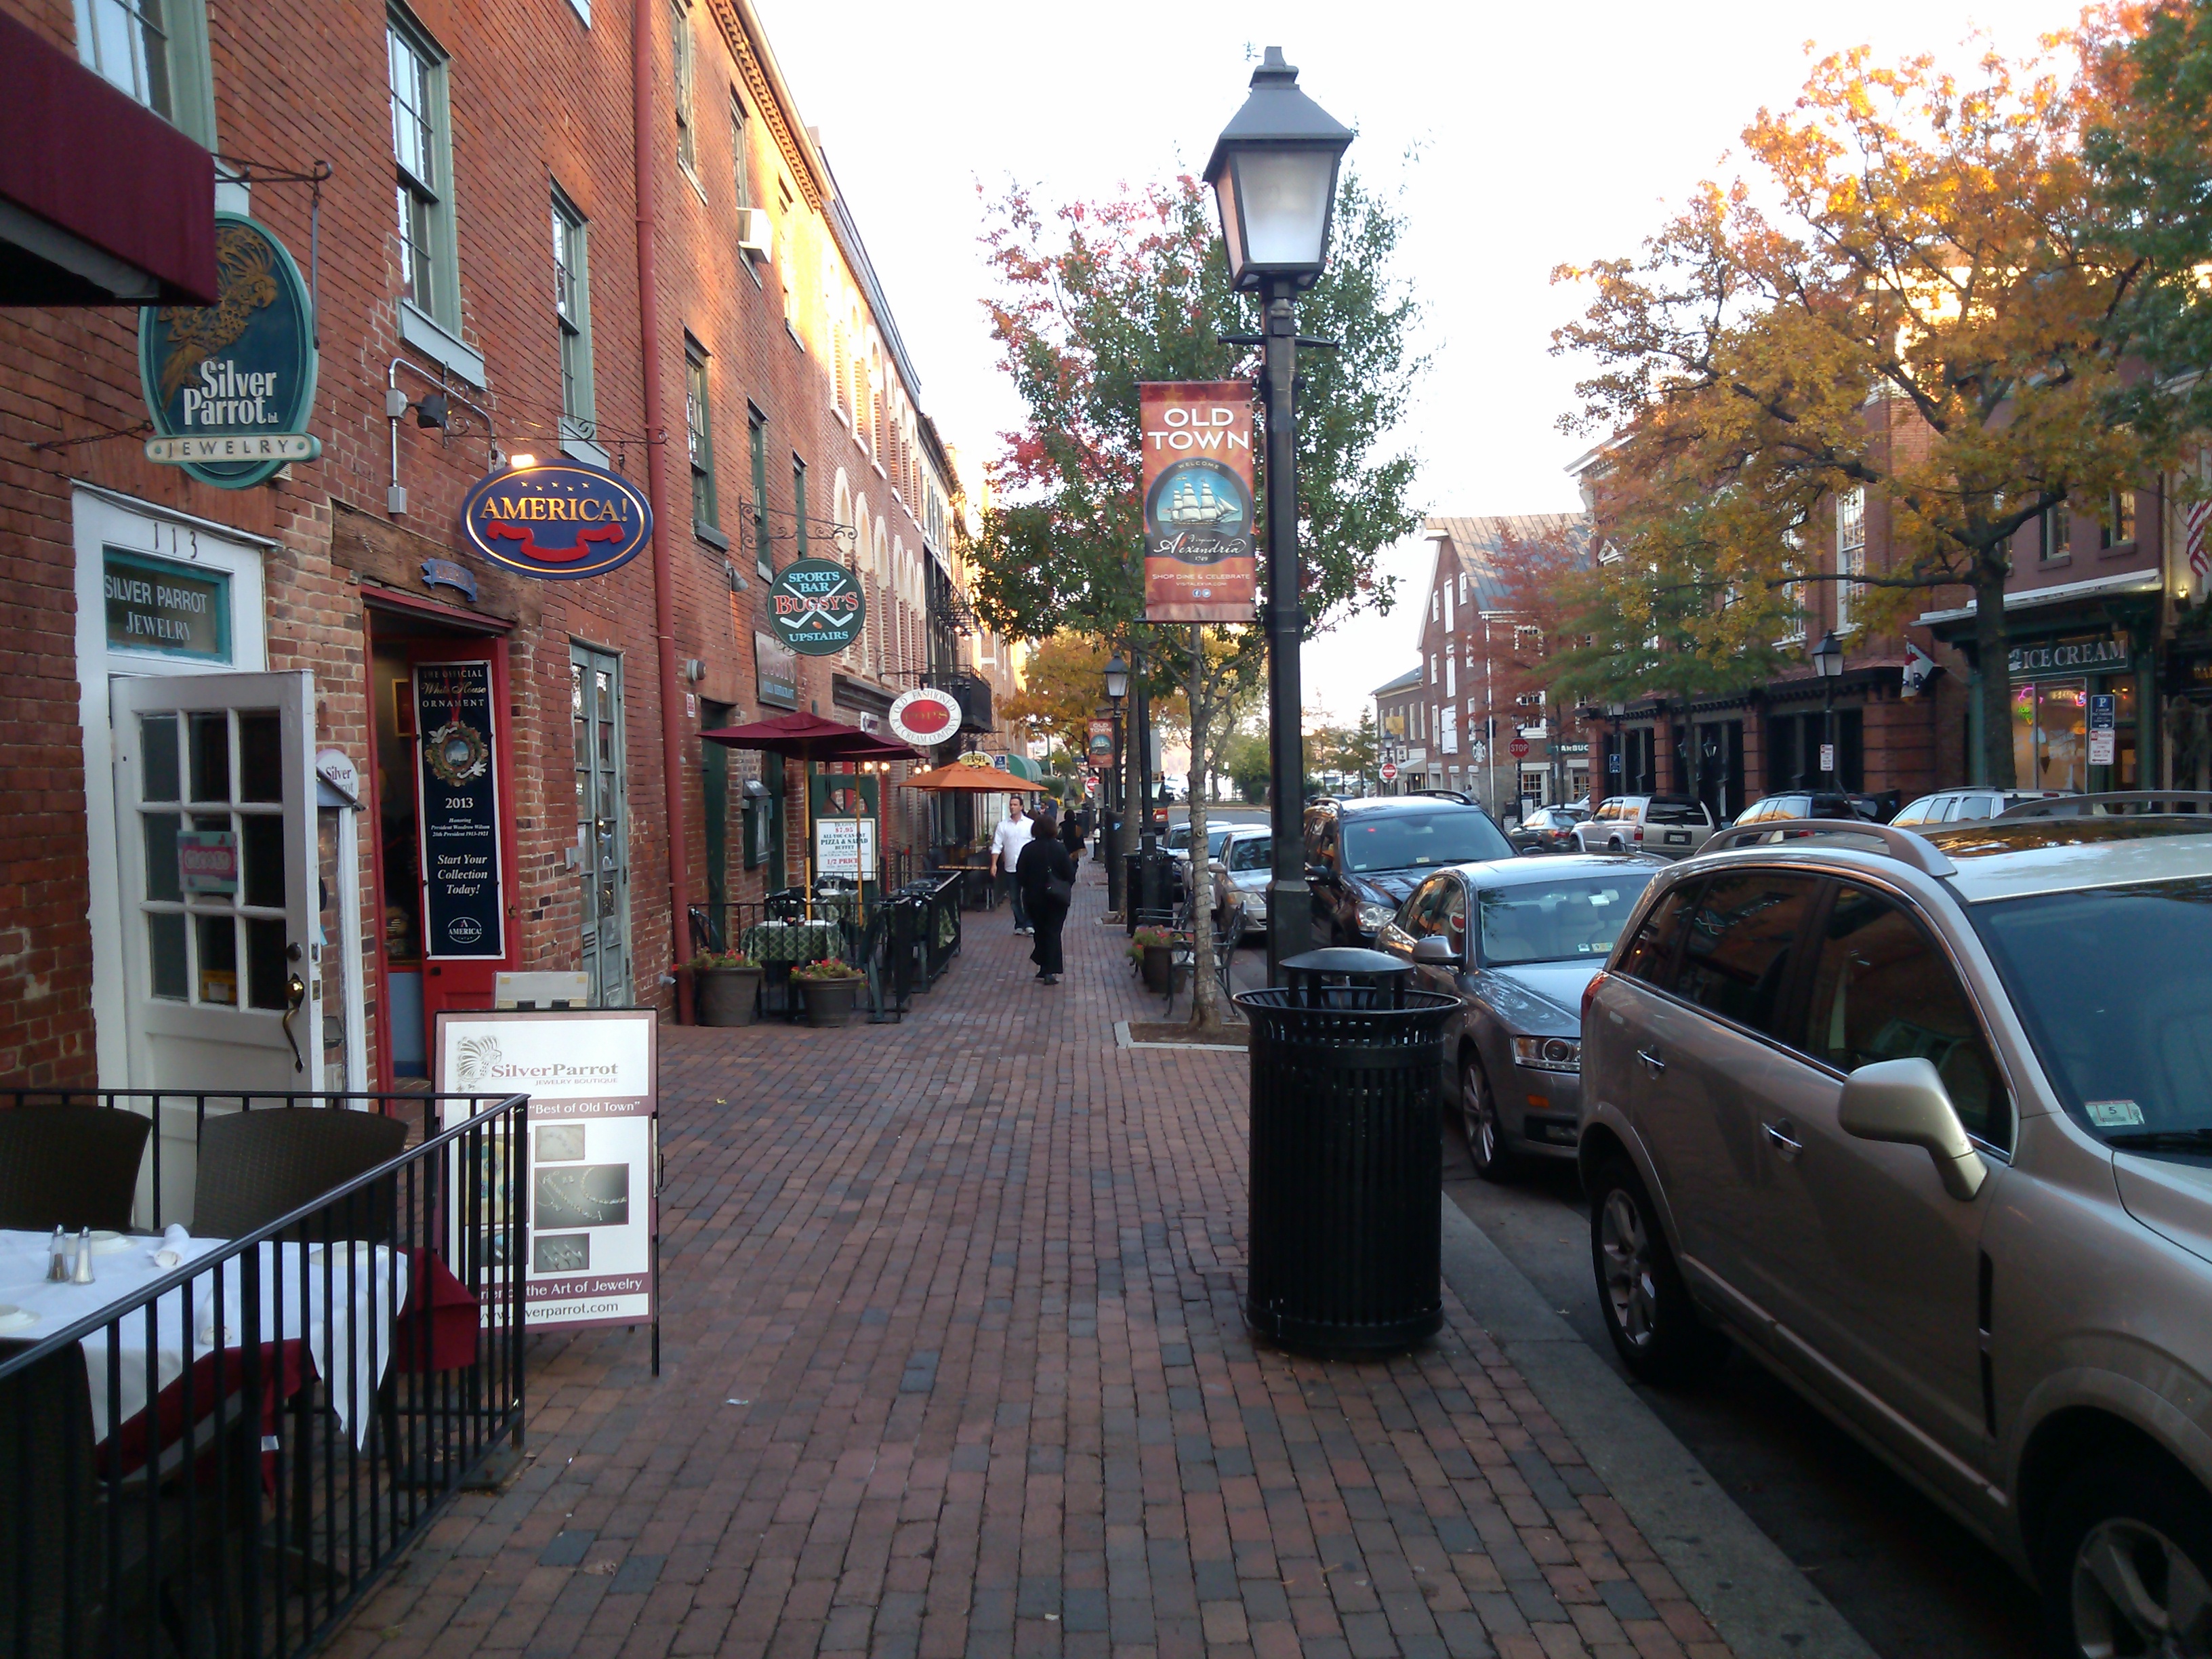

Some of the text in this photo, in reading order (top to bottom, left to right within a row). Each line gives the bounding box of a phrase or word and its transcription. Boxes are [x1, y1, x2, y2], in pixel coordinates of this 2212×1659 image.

[200, 360, 276, 398] Silver
[184, 388, 266, 425] Parrot
[1164, 408, 1234, 427] OLD
[169, 440, 288, 457] JEWELRY
[1147, 431, 1250, 451] TOWN
[1178, 461, 1219, 470] WELCOME
[479, 496, 629, 523] AMERICA!
[154, 522, 198, 560] 113
[1153, 531, 1246, 554] Alexandria
[788, 571, 840, 583] SPORTS
[104, 575, 207, 614] SILVER PARROT
[800, 582, 830, 592] BAR
[773, 592, 859, 615] BUGSY'S
[126, 611, 192, 641] JEWELRY
[788, 631, 848, 642] UPSTAIRS
[2023, 640, 2126, 669] ICE CREAM
[422, 699, 485, 708] ORNAMENT
[894, 691, 956, 714] OLD FASHIONED
[2099, 697, 2106, 708] P
[892, 718, 959, 743] ICE CREAM COMPANY
[1510, 744, 1528, 752] STOP
[326, 765, 352, 780] Silver
[445, 797, 474, 808] 2013
[437, 854, 488, 865] Start Your
[437, 869, 488, 880] Collection
[447, 884, 480, 897] Today!
[491, 1063, 619, 1078] SilverParrot
[564, 1103, 576, 1113] of
[579, 1102, 600, 1113] Old
[526, 1285, 548, 1296] the
[551, 1283, 571, 1295] Art
[575, 1281, 589, 1293] of
[592, 1277, 643, 1292] Jewelry
